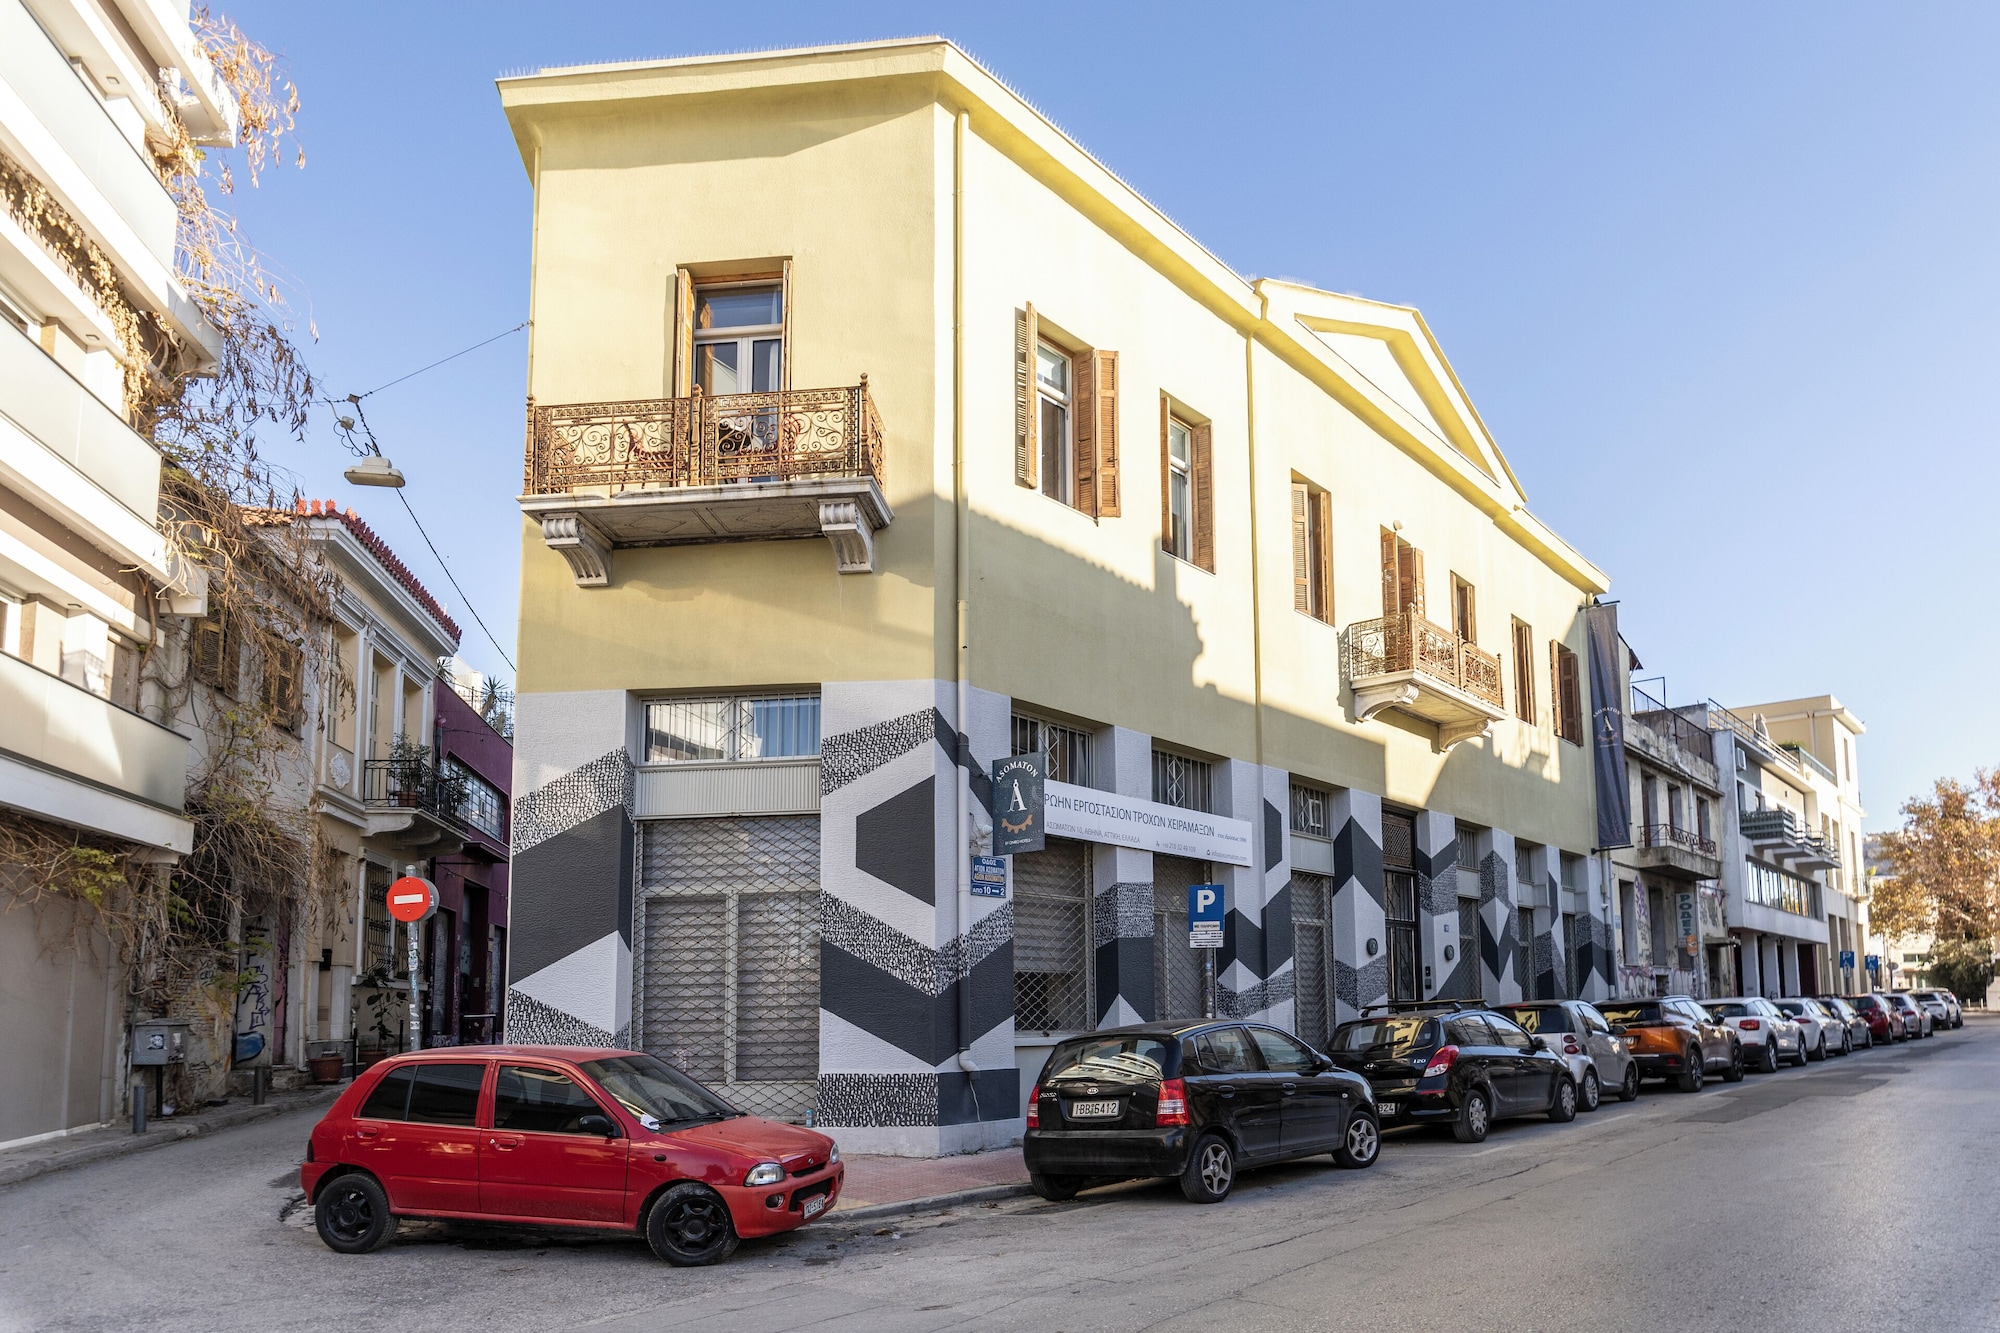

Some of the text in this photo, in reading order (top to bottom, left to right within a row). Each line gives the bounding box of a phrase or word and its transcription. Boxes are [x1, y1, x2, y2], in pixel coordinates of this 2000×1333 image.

[996, 761, 1039, 783] ASOMATON
[1044, 793, 1072, 810] ΡΩΗΝ
[1073, 799, 1132, 821] ΕΡΓΟΣΤΑΣΙΟΝ
[1132, 810, 1166, 828] ΤΡΟΧΩΝ
[1167, 817, 1215, 837] ΧΕΙΡΑΜΑΞΩΝ
[981, 858, 997, 866] ΟΔΟΣ
[983, 886, 991, 895] 10
[1000, 887, 1005, 896] 2
[1197, 889, 1216, 913] P
